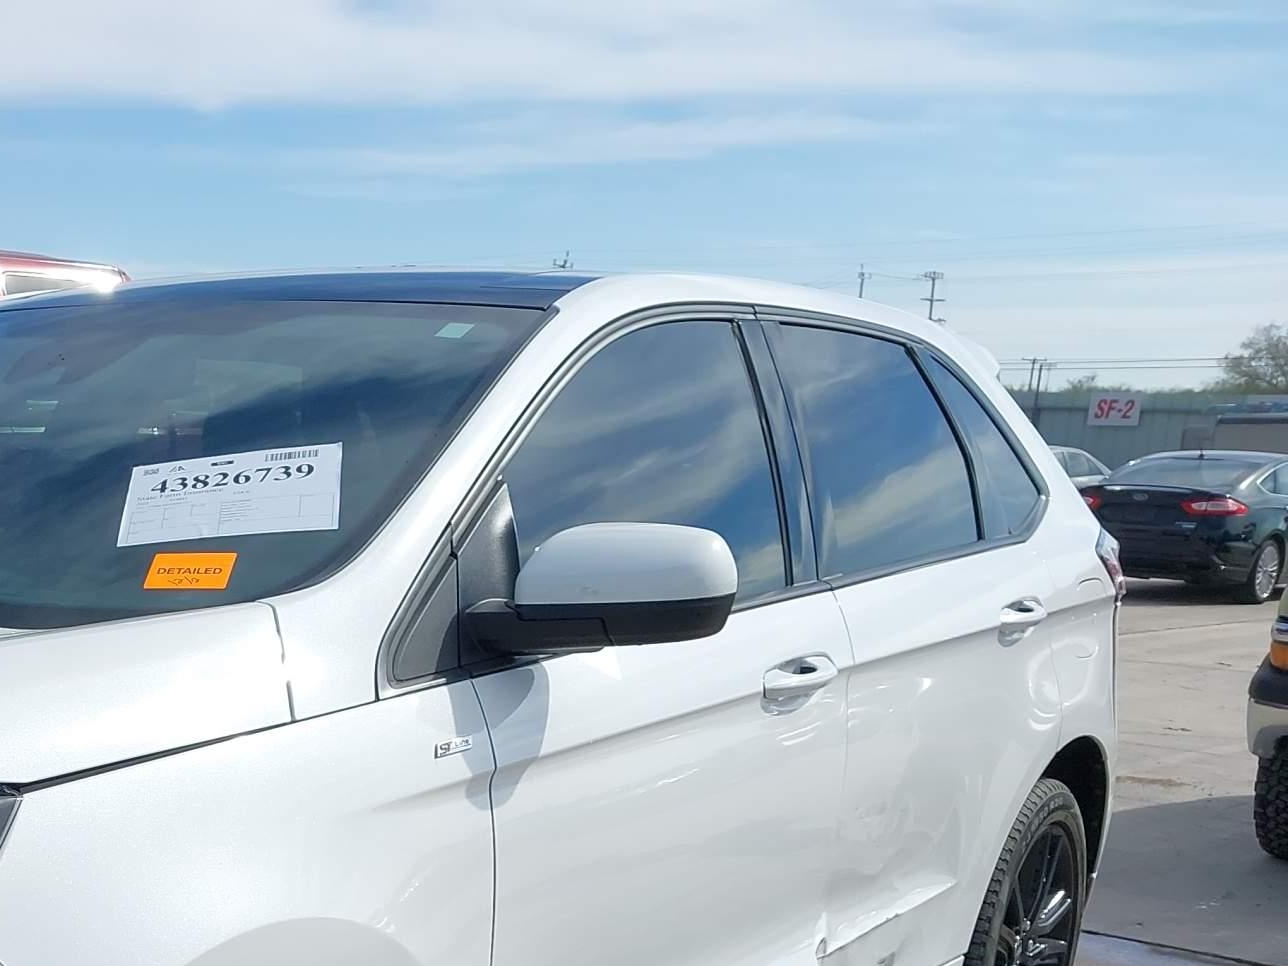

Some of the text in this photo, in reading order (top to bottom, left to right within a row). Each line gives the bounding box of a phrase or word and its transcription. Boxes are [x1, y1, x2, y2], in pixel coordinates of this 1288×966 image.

[1094, 399, 1135, 419] SF-2
[151, 463, 315, 494] 43826739
[156, 566, 223, 575] DETAILED
